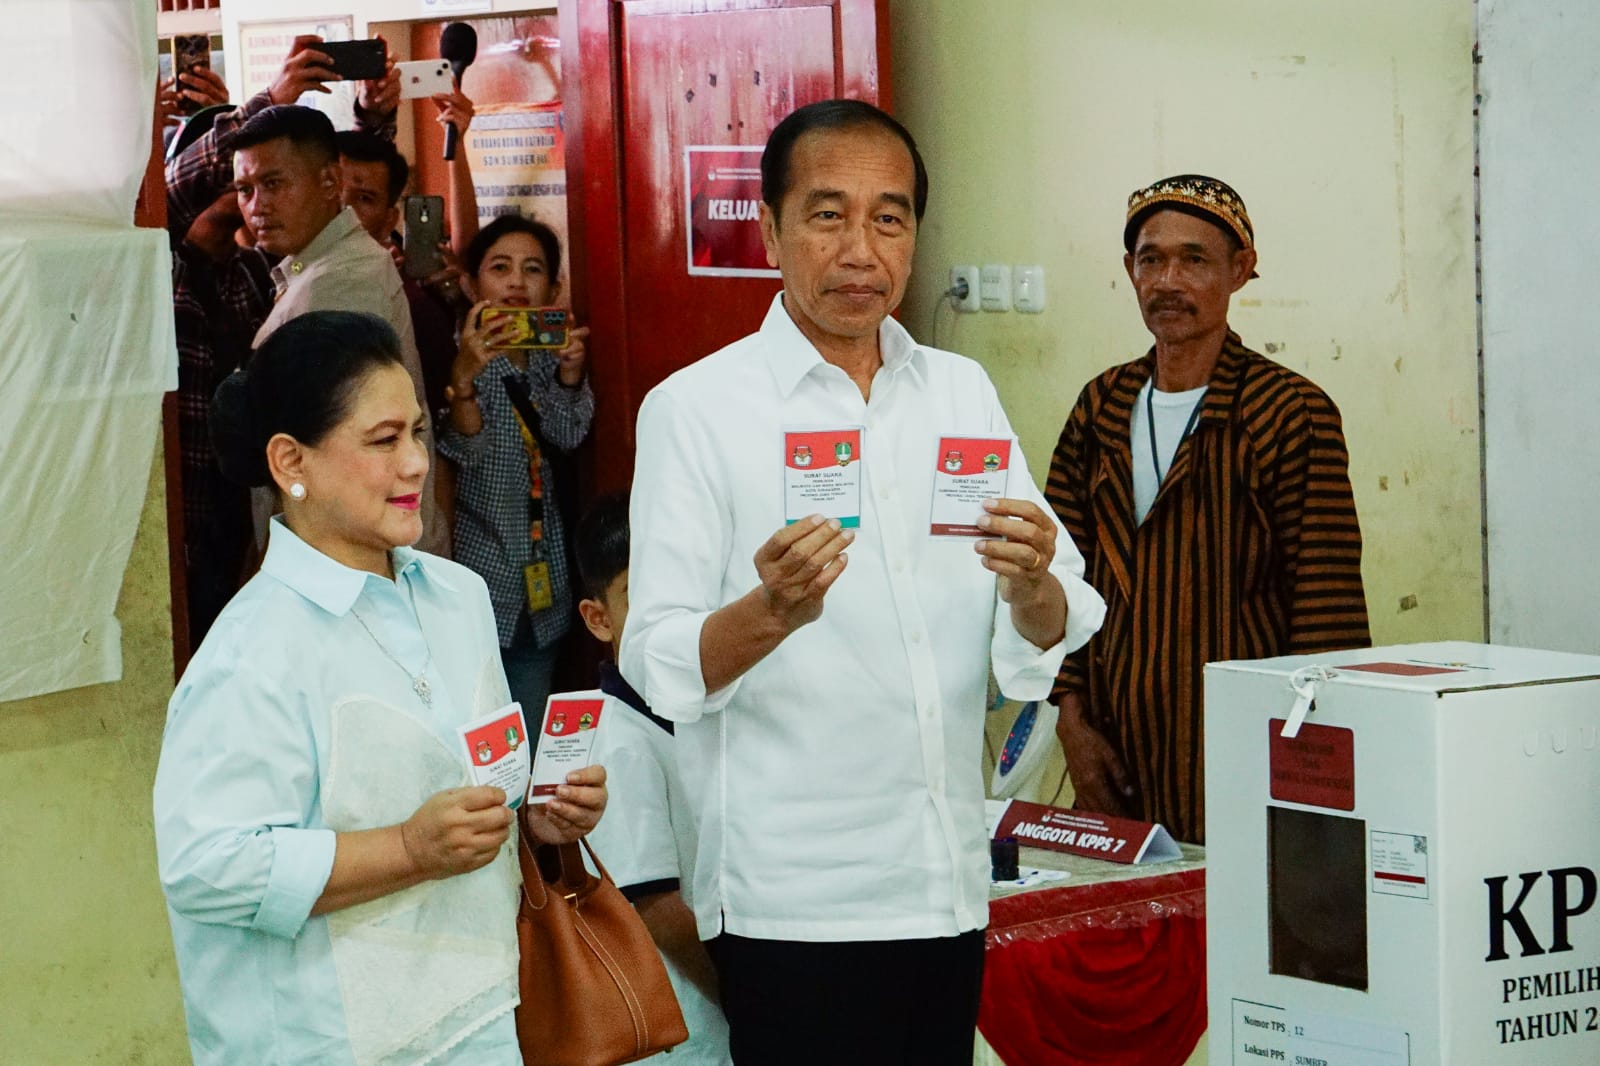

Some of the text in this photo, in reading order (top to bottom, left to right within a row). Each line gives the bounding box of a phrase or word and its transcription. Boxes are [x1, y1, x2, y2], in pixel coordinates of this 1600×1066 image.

[708, 199, 760, 221] KELUA
[1012, 822, 1076, 844] ANGGOTA
[1076, 832, 1114, 852] KPPS
[1112, 839, 1127, 853] 7
[1483, 866, 1598, 963] KP
[1502, 966, 1600, 1004] PEMILIH
[1244, 1016, 1269, 1029] Nomor
[1271, 1021, 1286, 1033] TPS
[1295, 1025, 1304, 1036] 12
[1496, 1006, 1600, 1045] TAHUN 2
[1244, 1043, 1269, 1058] Lokasi
[1270, 1048, 1285, 1061] PPS
[1295, 1055, 1328, 1066] SUMBER
